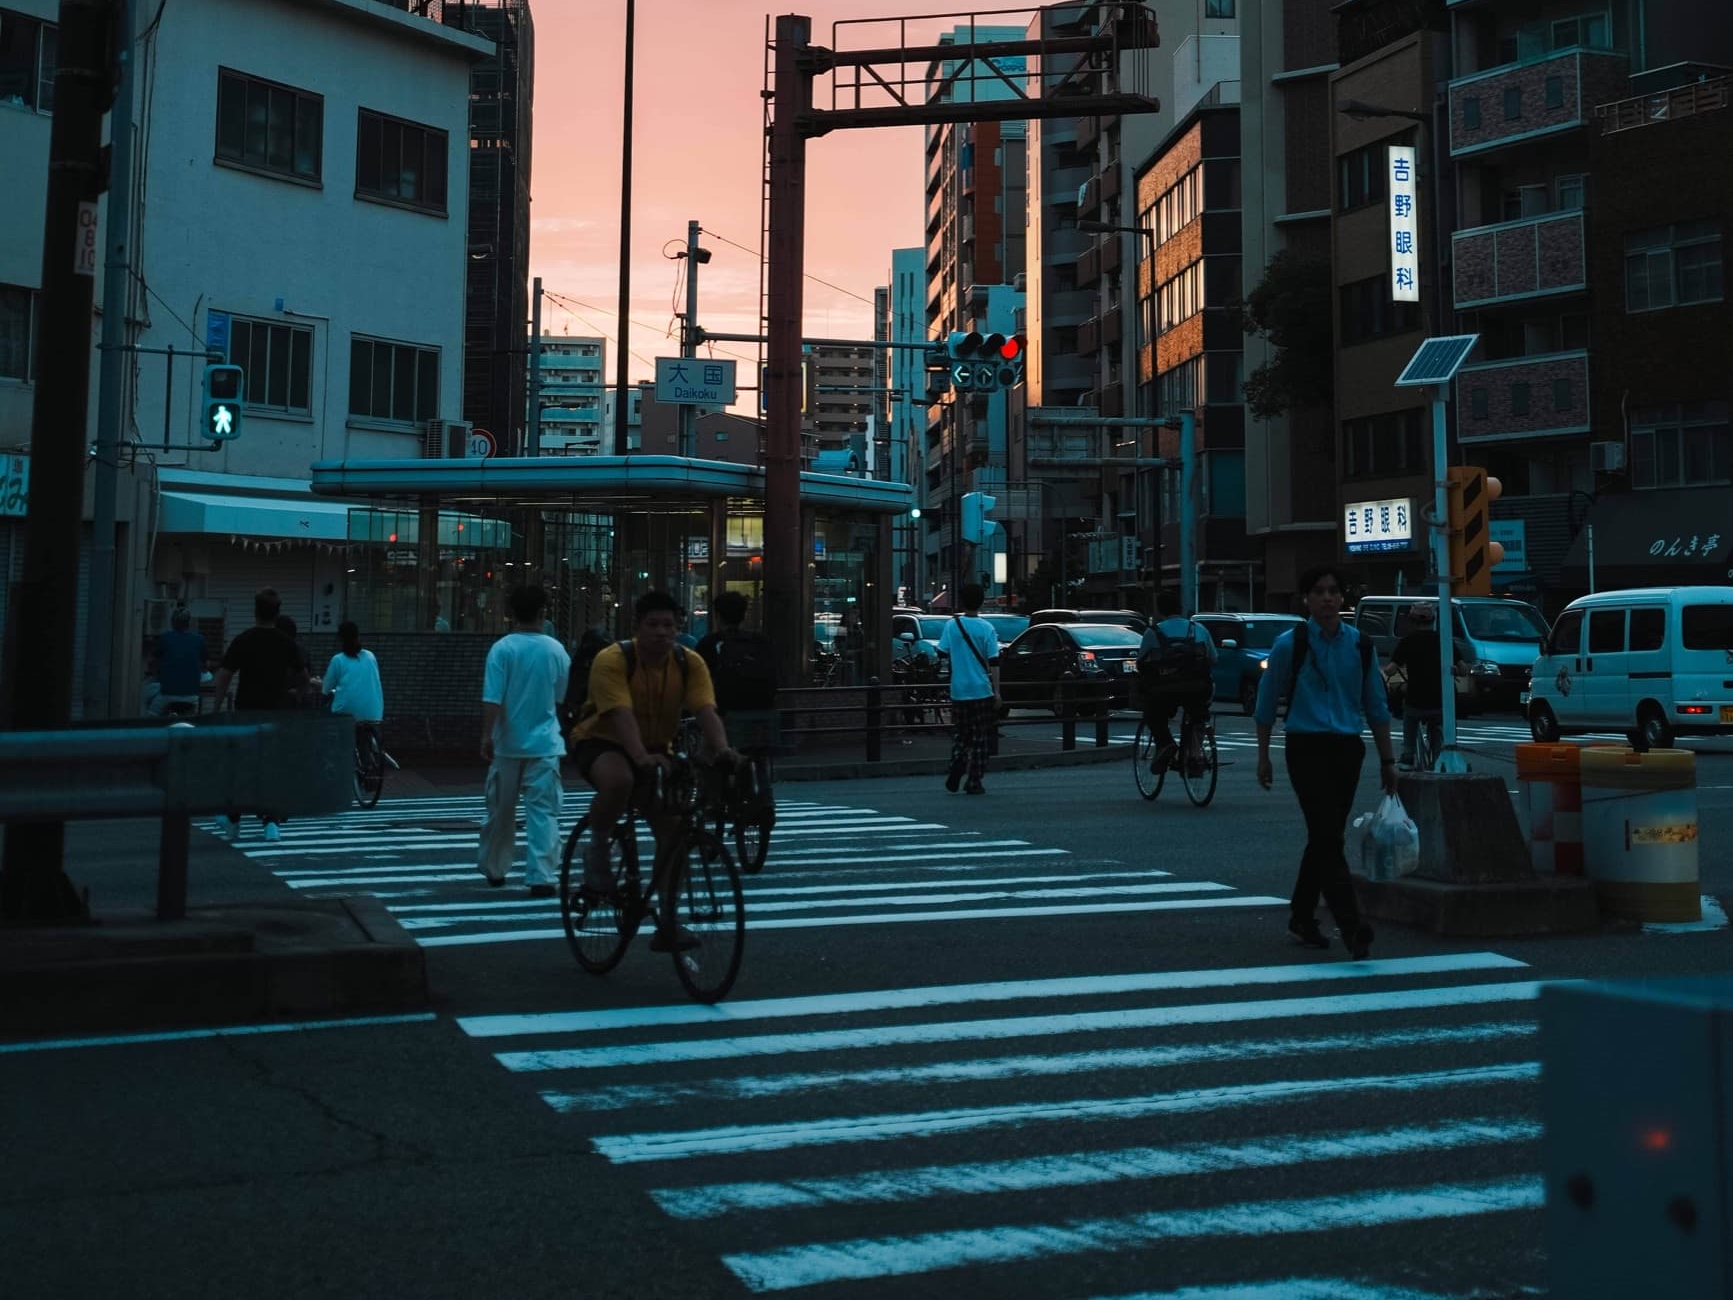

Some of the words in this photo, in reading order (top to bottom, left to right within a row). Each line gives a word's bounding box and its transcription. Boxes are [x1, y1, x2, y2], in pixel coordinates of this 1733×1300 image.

[1394, 157, 1413, 291] 吉野眼科
[668, 363, 723, 385] 大国
[674, 387, 717, 399] Daikoku
[1348, 504, 1407, 535] 吉野眼科
[1649, 533, 1720, 557] のんき亭
